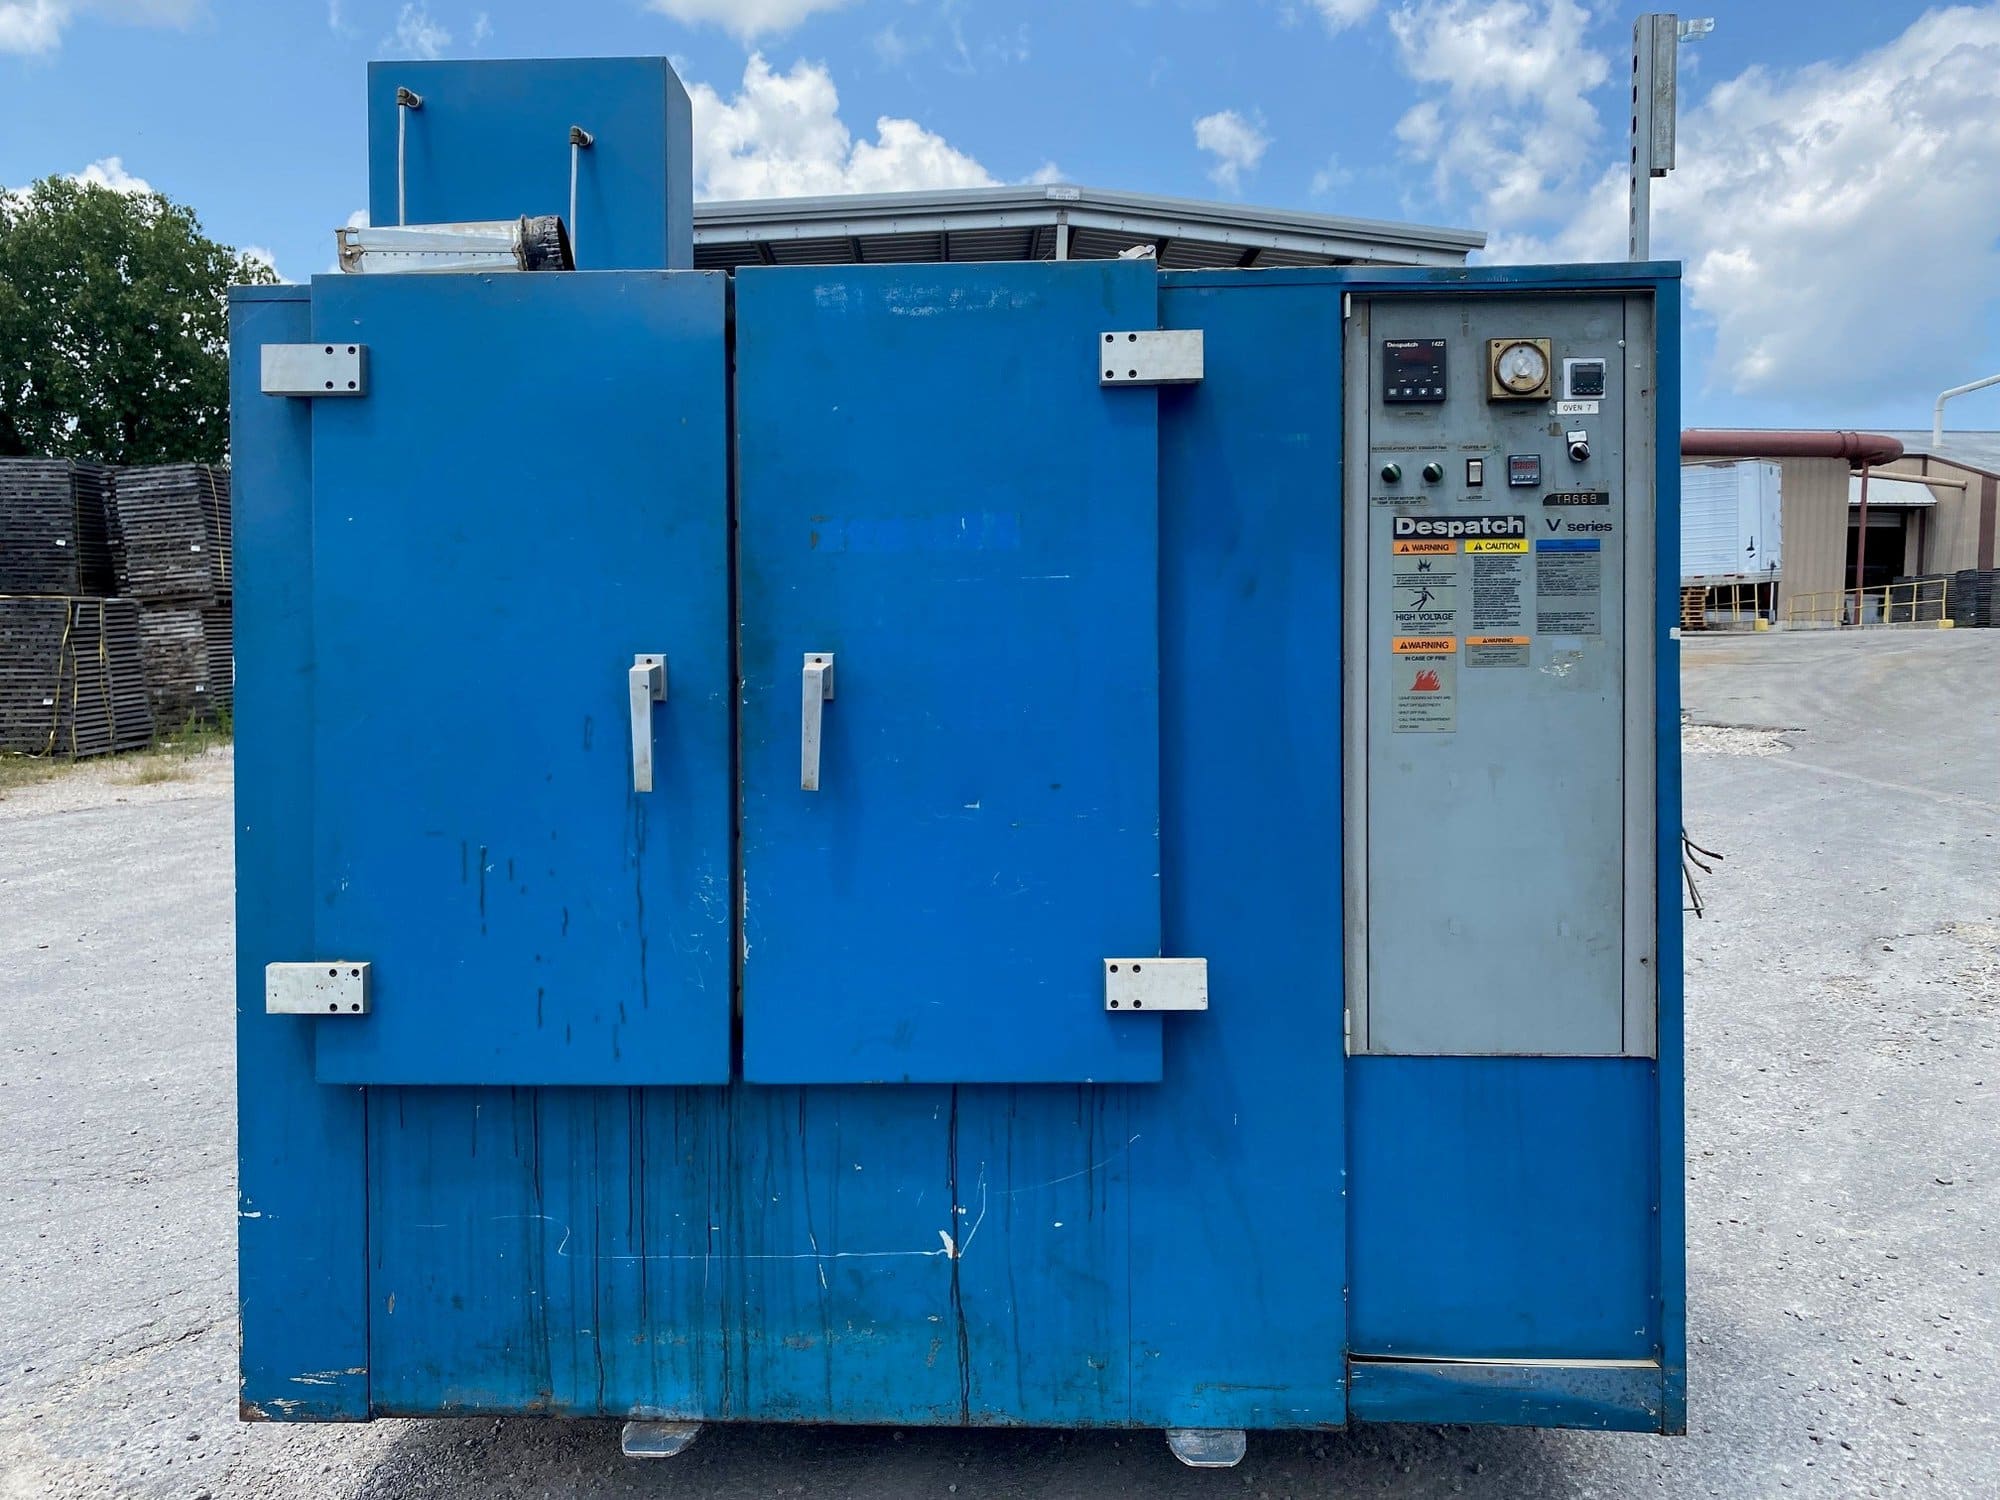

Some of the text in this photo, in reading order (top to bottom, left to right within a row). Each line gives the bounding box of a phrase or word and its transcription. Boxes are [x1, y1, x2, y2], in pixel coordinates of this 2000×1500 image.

[1563, 404, 1583, 412] OVEN
[1396, 517, 1523, 537] Despatch
[1546, 519, 1613, 531] V series
[1412, 543, 1449, 551] WARNING
[1485, 542, 1520, 550] CAUTION
[1395, 613, 1453, 621] HIGH VOLTAGE
[1408, 641, 1449, 649] WARNING
